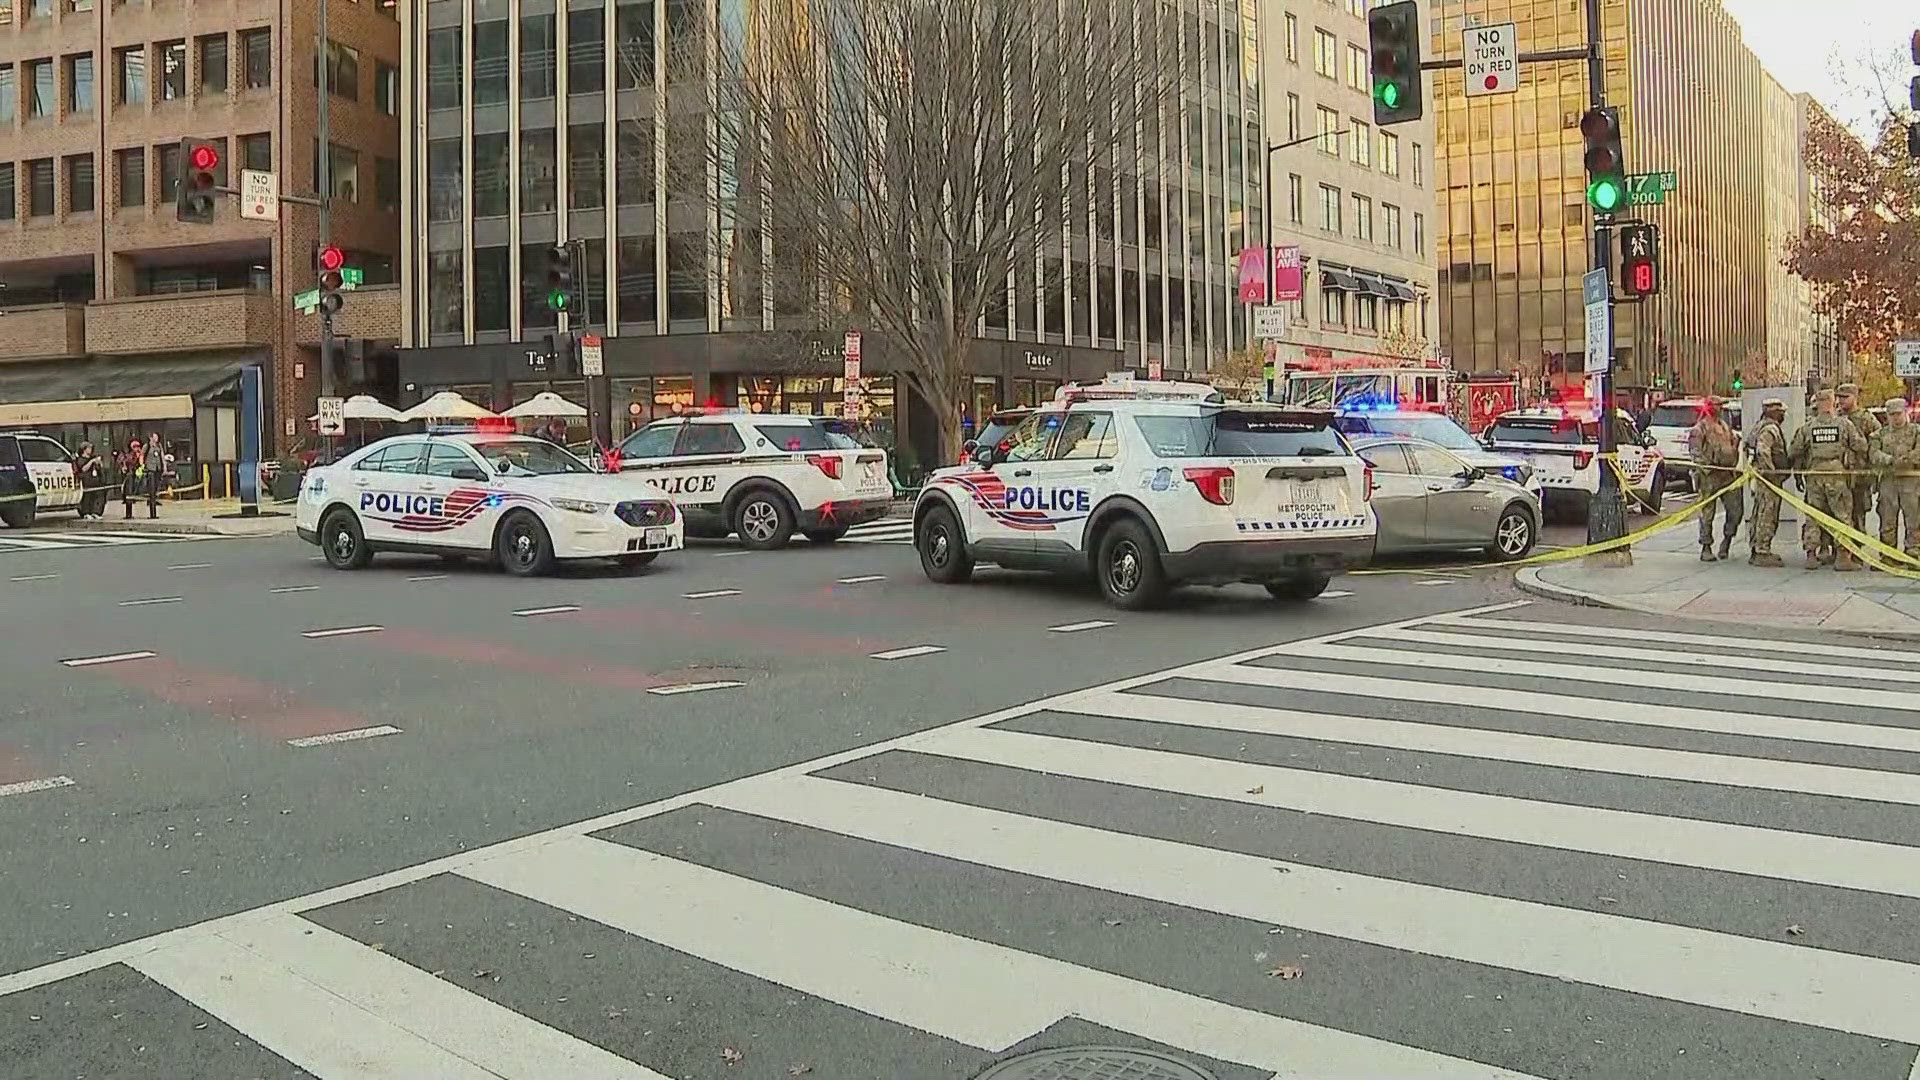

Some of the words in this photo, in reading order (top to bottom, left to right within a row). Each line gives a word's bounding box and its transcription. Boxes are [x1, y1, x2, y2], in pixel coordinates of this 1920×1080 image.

[1478, 30, 1500, 45] NO
[1475, 46, 1505, 60] TURN
[1469, 63, 1485, 75] ON
[1490, 59, 1512, 72] RED
[252, 174, 268, 185] NO
[1624, 175, 1649, 192] 17
[1660, 173, 1673, 183] ST
[251, 185, 271, 194] TURN
[246, 194, 256, 202] ON
[259, 196, 275, 204] RED
[1631, 193, 1657, 204] 900
[1276, 248, 1299, 259] ART
[1276, 259, 1299, 269] AVE
[1261, 318, 1278, 326] MUST
[1024, 351, 1053, 366] Tatte
[322, 401, 340, 410] ONE
[321, 411, 341, 419] WAY
[36, 477, 73, 490] POLICE
[360, 492, 444, 516] POLICE
[1005, 486, 1090, 512] POLICE
[1278, 504, 1336, 513] METROPOLITAN
